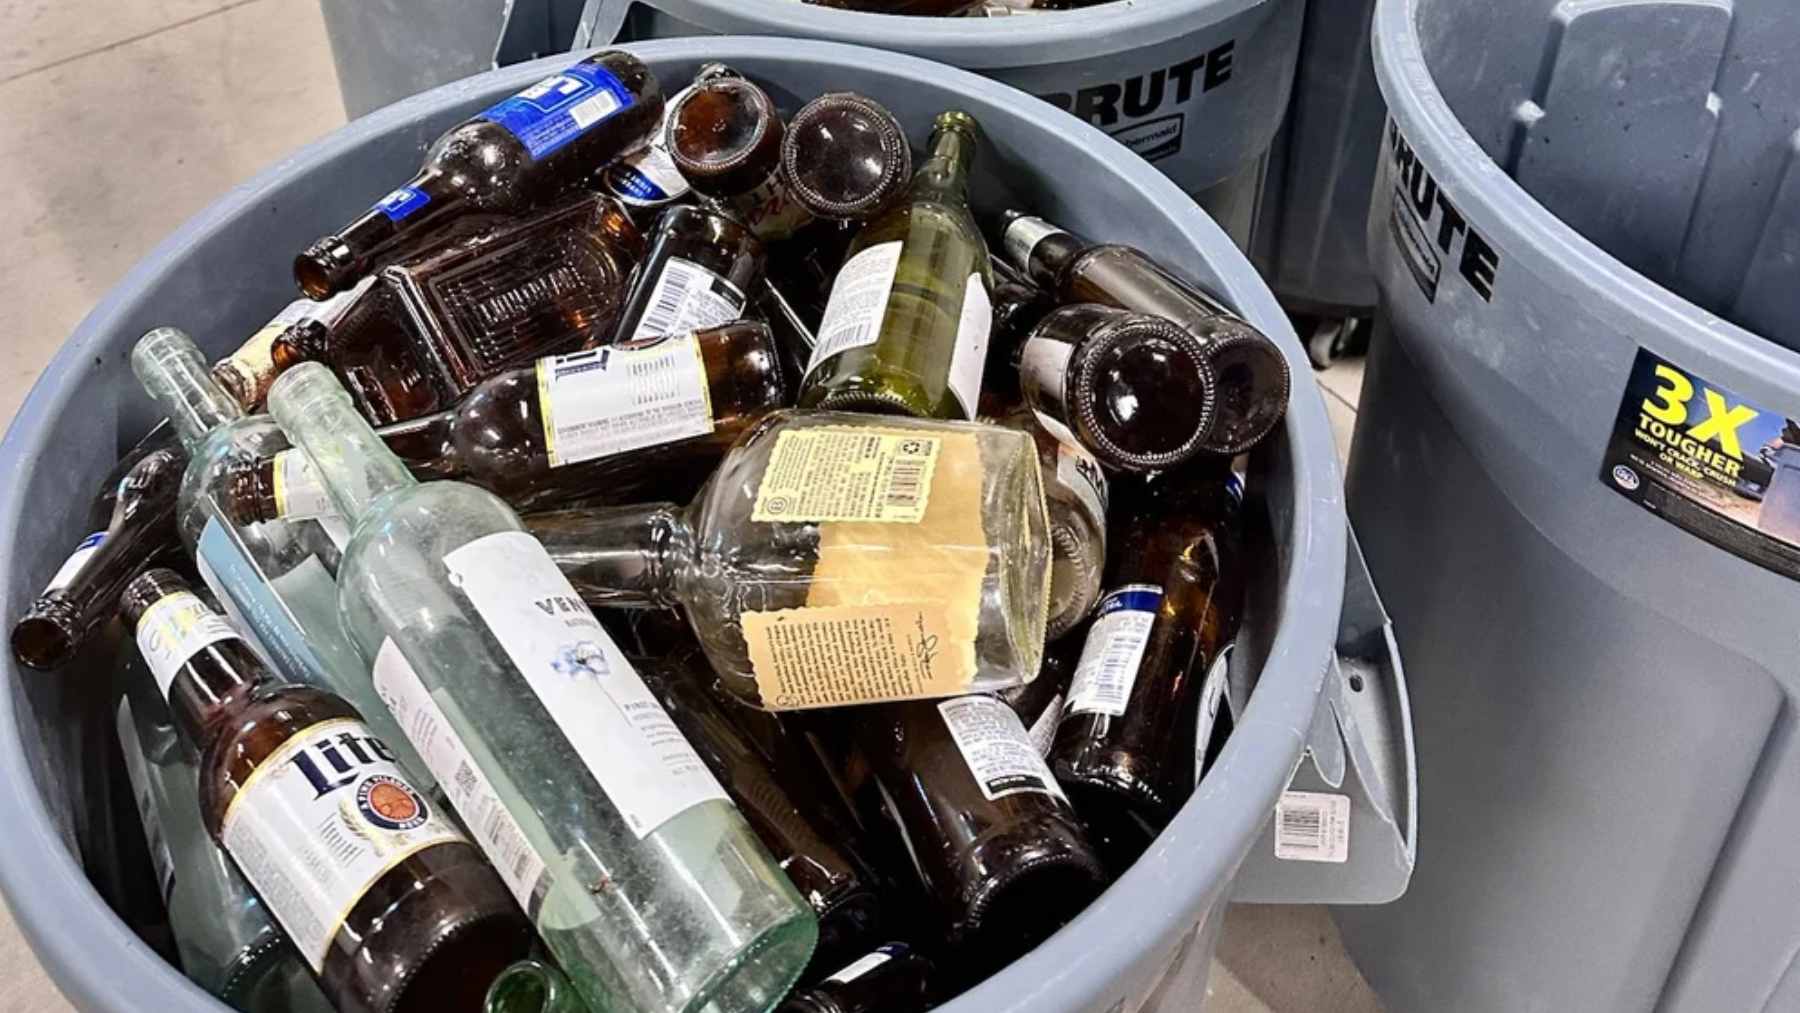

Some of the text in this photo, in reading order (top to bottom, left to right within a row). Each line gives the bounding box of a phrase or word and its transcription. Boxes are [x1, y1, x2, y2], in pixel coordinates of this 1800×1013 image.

[1635, 429, 1666, 452] WON'T
[1703, 466, 1737, 487] CRUSH
[1639, 413, 1741, 478] TOUGHER
[1659, 453, 1675, 466] OR
[290, 732, 396, 800] Lite
